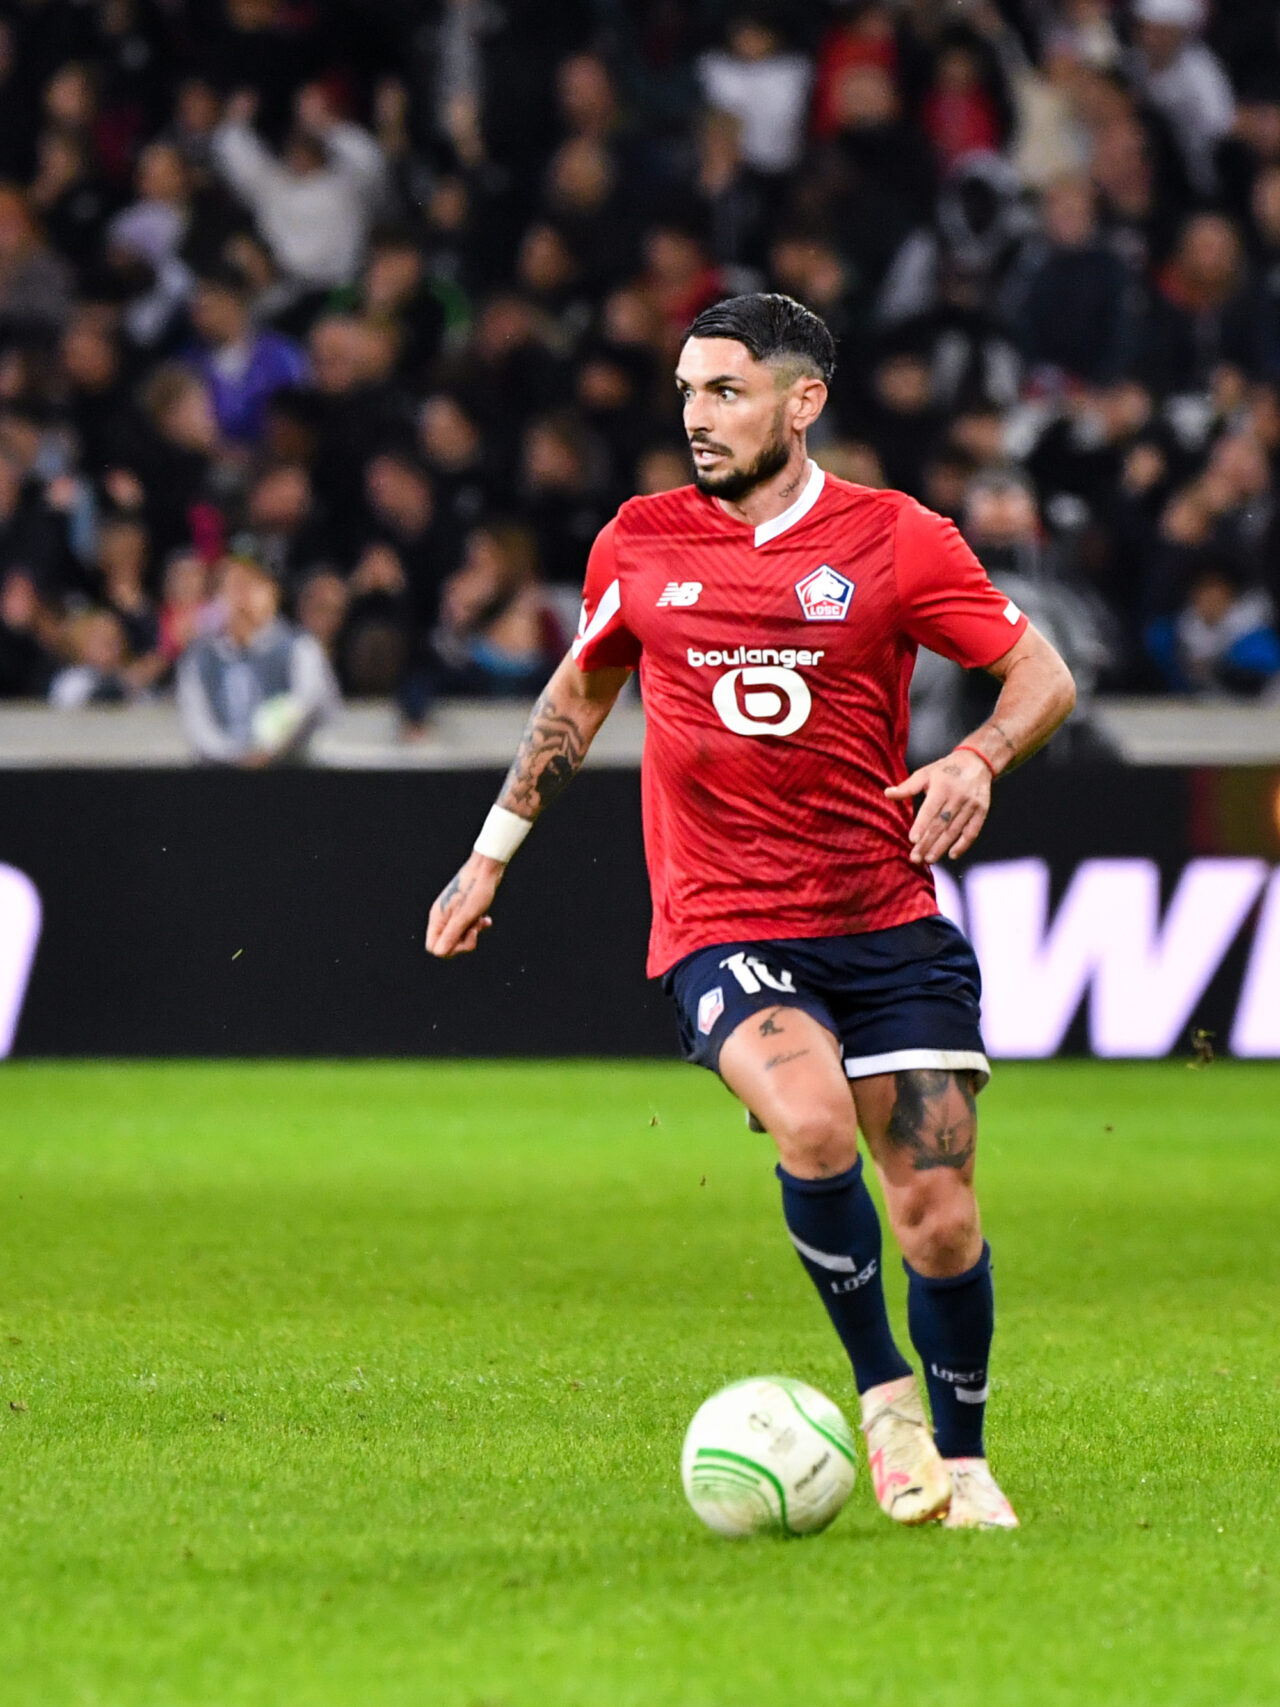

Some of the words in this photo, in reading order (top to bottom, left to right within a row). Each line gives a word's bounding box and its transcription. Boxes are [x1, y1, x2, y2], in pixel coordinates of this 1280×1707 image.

[656, 582, 703, 607] NB
[809, 604, 842, 616] LOSC
[687, 646, 825, 669] boulanger
[831, 1259, 877, 1294] LOSC
[931, 1363, 984, 1384] LOSC
